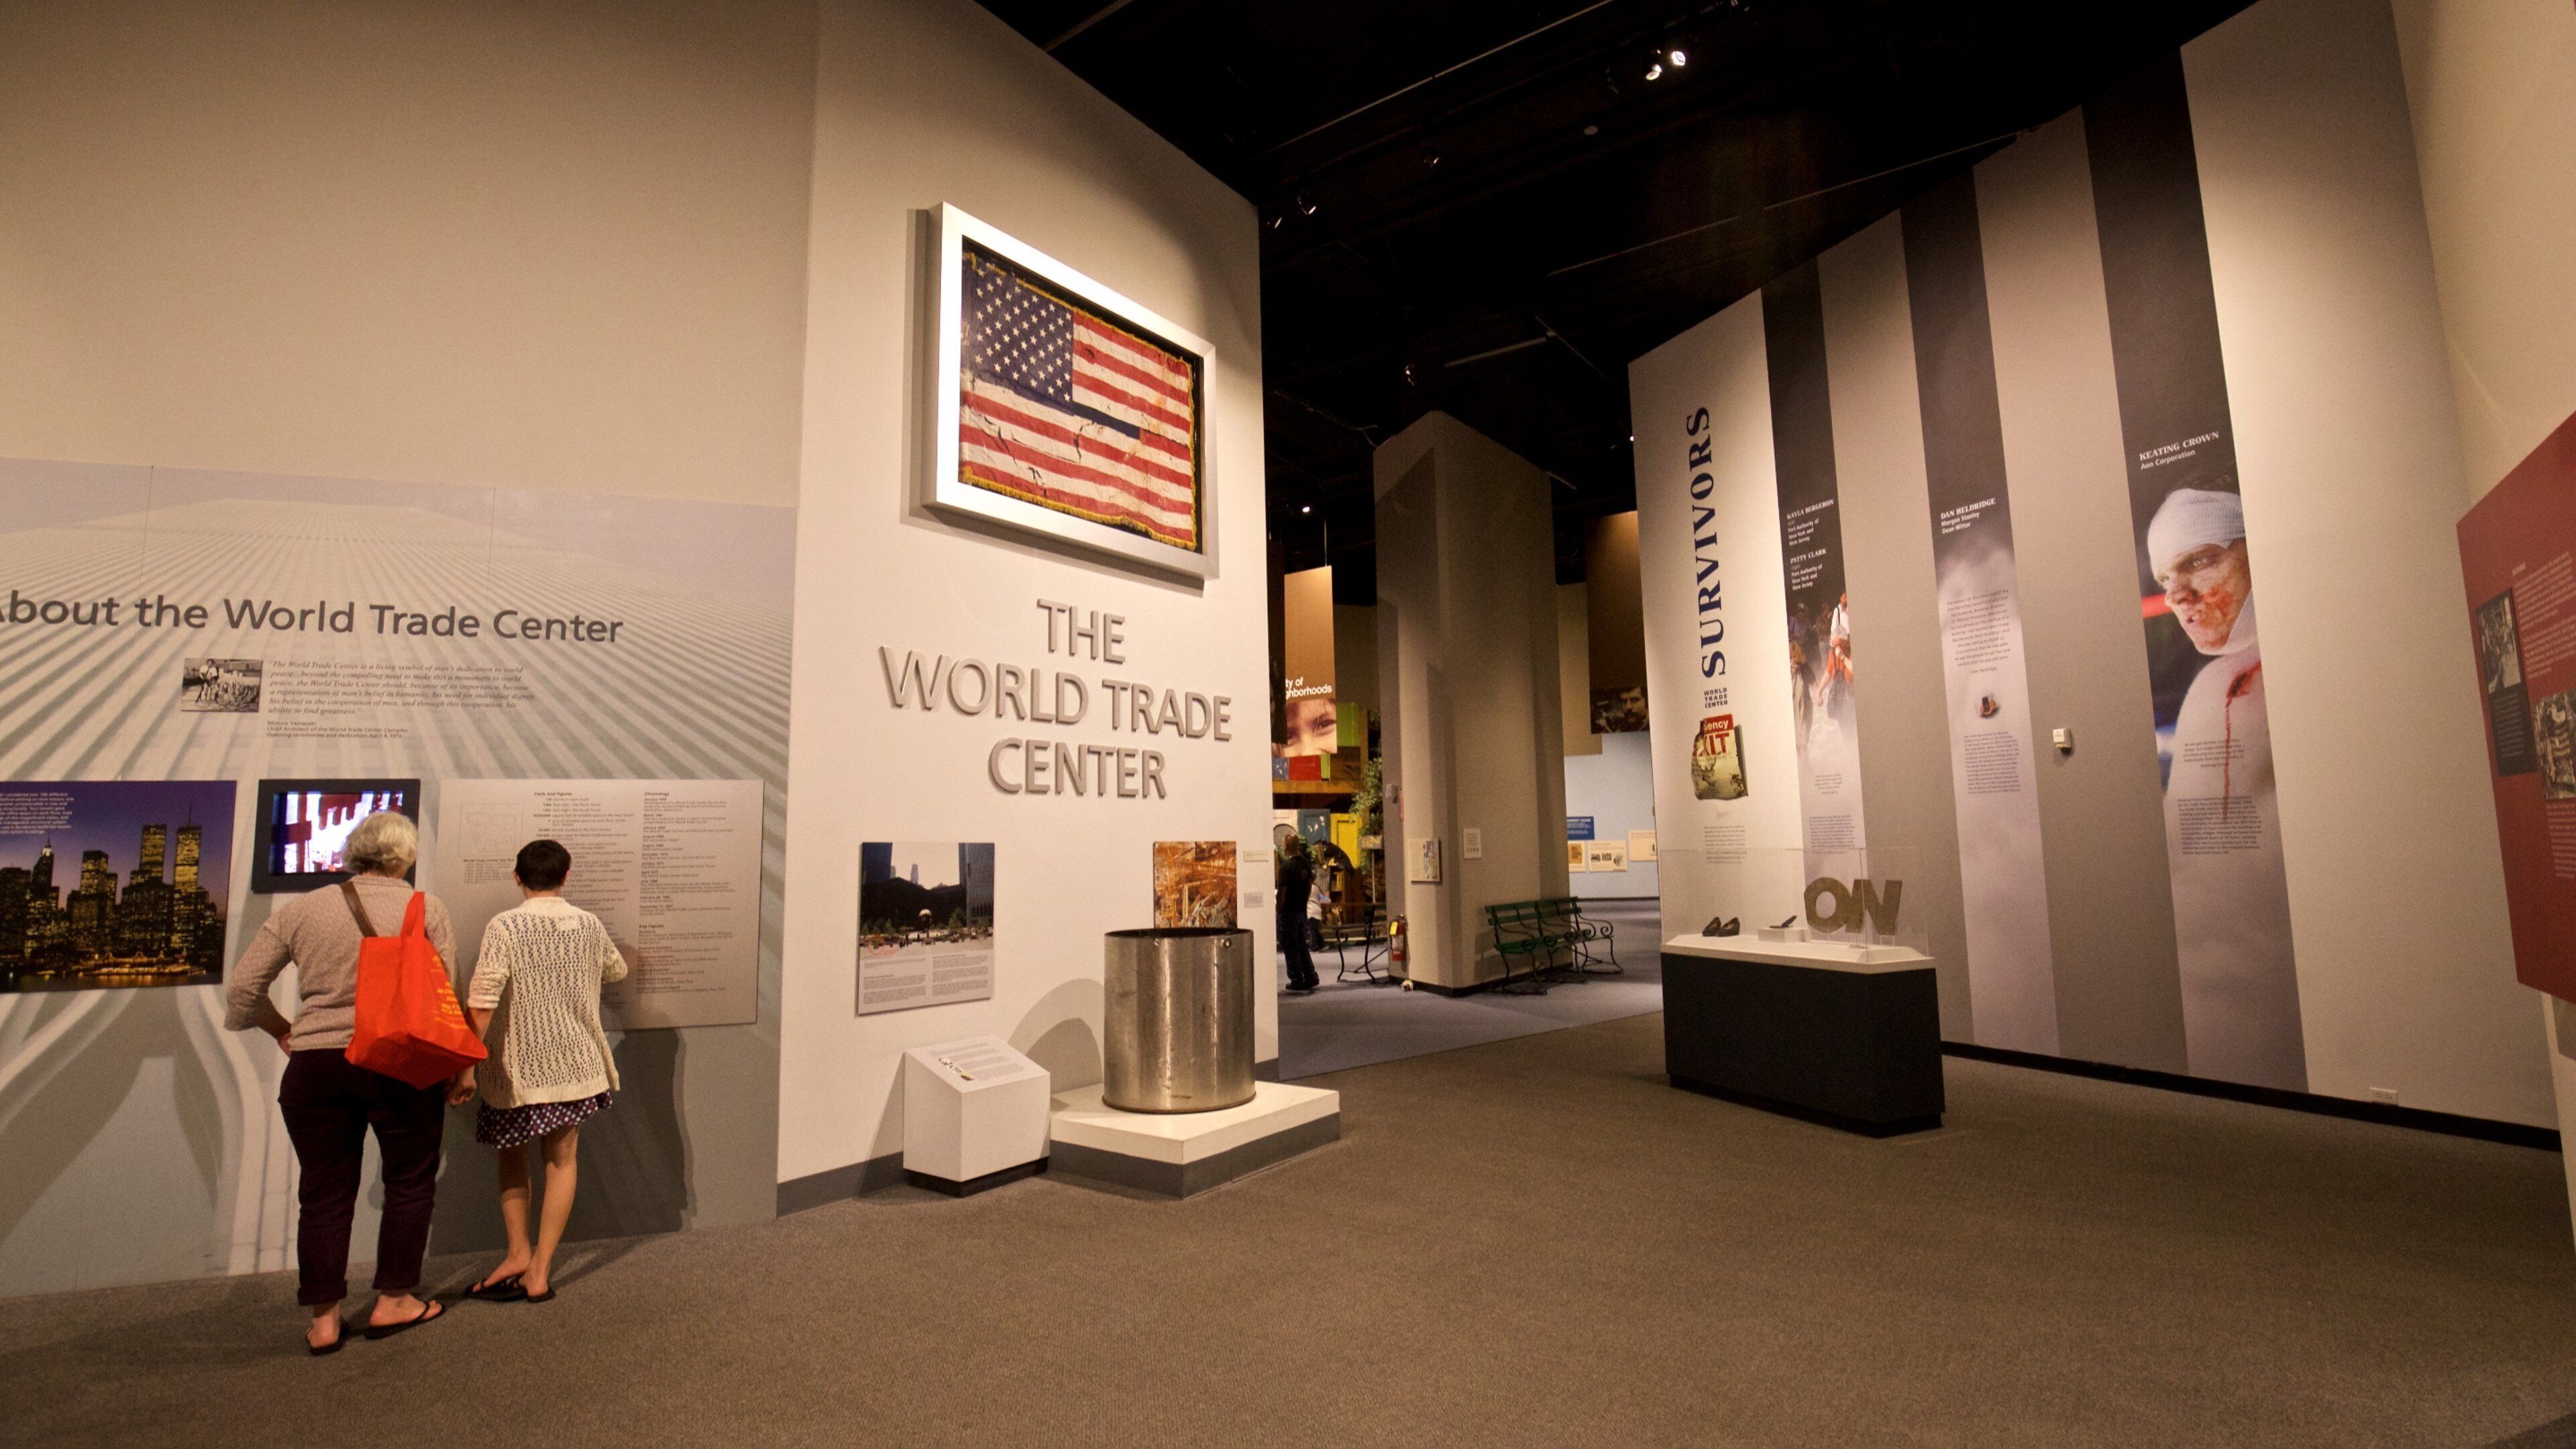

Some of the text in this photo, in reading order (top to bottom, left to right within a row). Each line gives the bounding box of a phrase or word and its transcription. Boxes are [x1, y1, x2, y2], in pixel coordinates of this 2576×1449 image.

[2139, 431, 2220, 461] KEATING CROWN
[2141, 449, 2196, 470] Aon Corporation
[1786, 498, 1834, 520] KAYLA BERGERON
[1941, 497, 1996, 519] DAN HELDRIDGE
[1941, 512, 1980, 527] Morgan Stanley
[1942, 522, 1971, 535] Dean Witter
[1686, 407, 1725, 678] SURVIVORS
[1790, 548, 1827, 564] PATTY CLARK
[0, 590, 624, 643] bout the World Trade Center
[1037, 598, 1126, 664] THE
[1295, 676, 1304, 687] of
[1704, 687, 1727, 696] WORLD
[878, 645, 1232, 741] WORLD TRADE
[1705, 694, 1728, 702] TRADE
[1705, 700, 1728, 708] CENTER
[1693, 732, 1730, 757] XIT
[988, 738, 1167, 799] CENTER
[1804, 877, 1903, 936] ON
